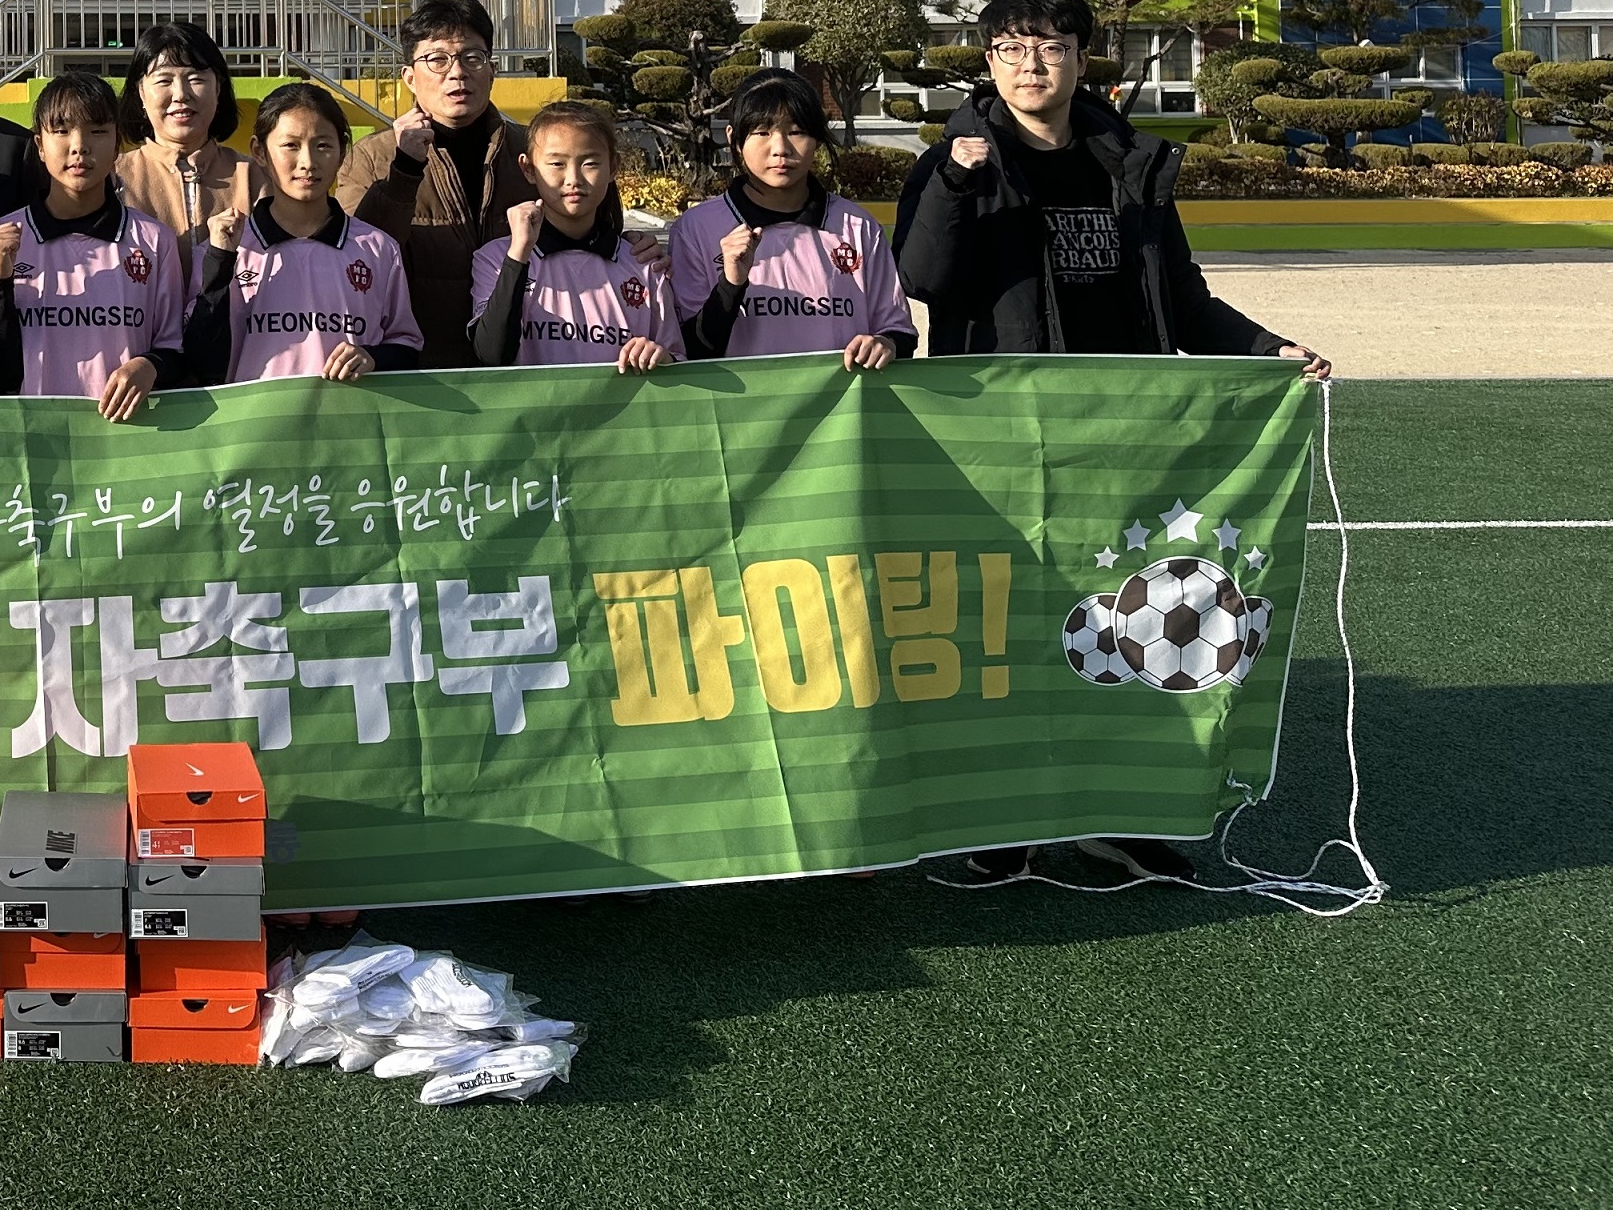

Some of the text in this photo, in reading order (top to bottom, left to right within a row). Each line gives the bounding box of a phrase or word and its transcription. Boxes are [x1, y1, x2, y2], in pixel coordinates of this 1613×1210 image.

[1051, 250, 1121, 269] RBAUD
[16, 305, 145, 328] MYEONGSEO
[740, 296, 855, 318] YEONGSEO
[521, 320, 634, 347] MYEONGSE
[203, 473, 340, 554] 열정을
[351, 464, 573, 541] 응원합니다
[593, 551, 1011, 726] 파이팅!
